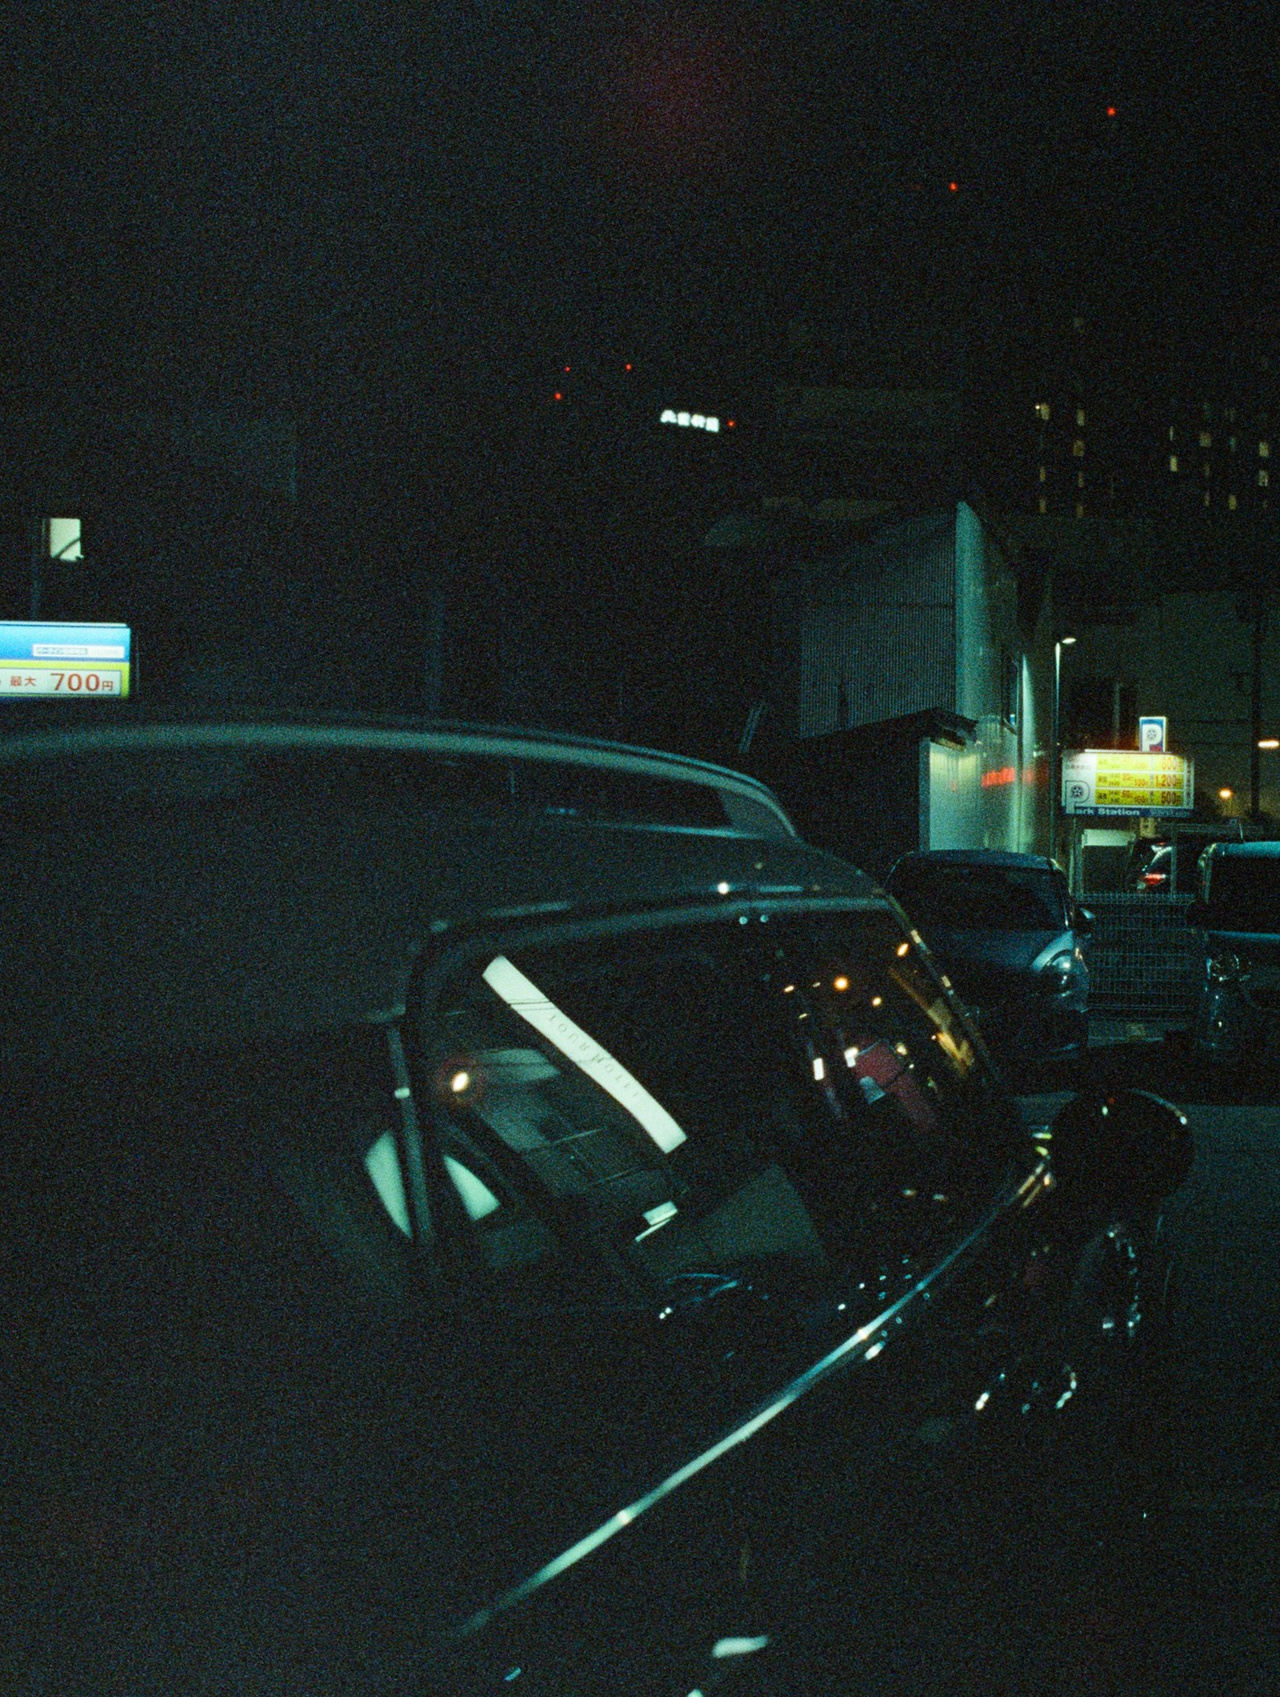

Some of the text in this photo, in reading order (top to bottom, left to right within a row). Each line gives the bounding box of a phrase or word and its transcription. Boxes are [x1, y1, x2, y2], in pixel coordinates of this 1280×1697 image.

[10, 673, 114, 692] 最大 700円
[1098, 808, 1140, 816] Station
